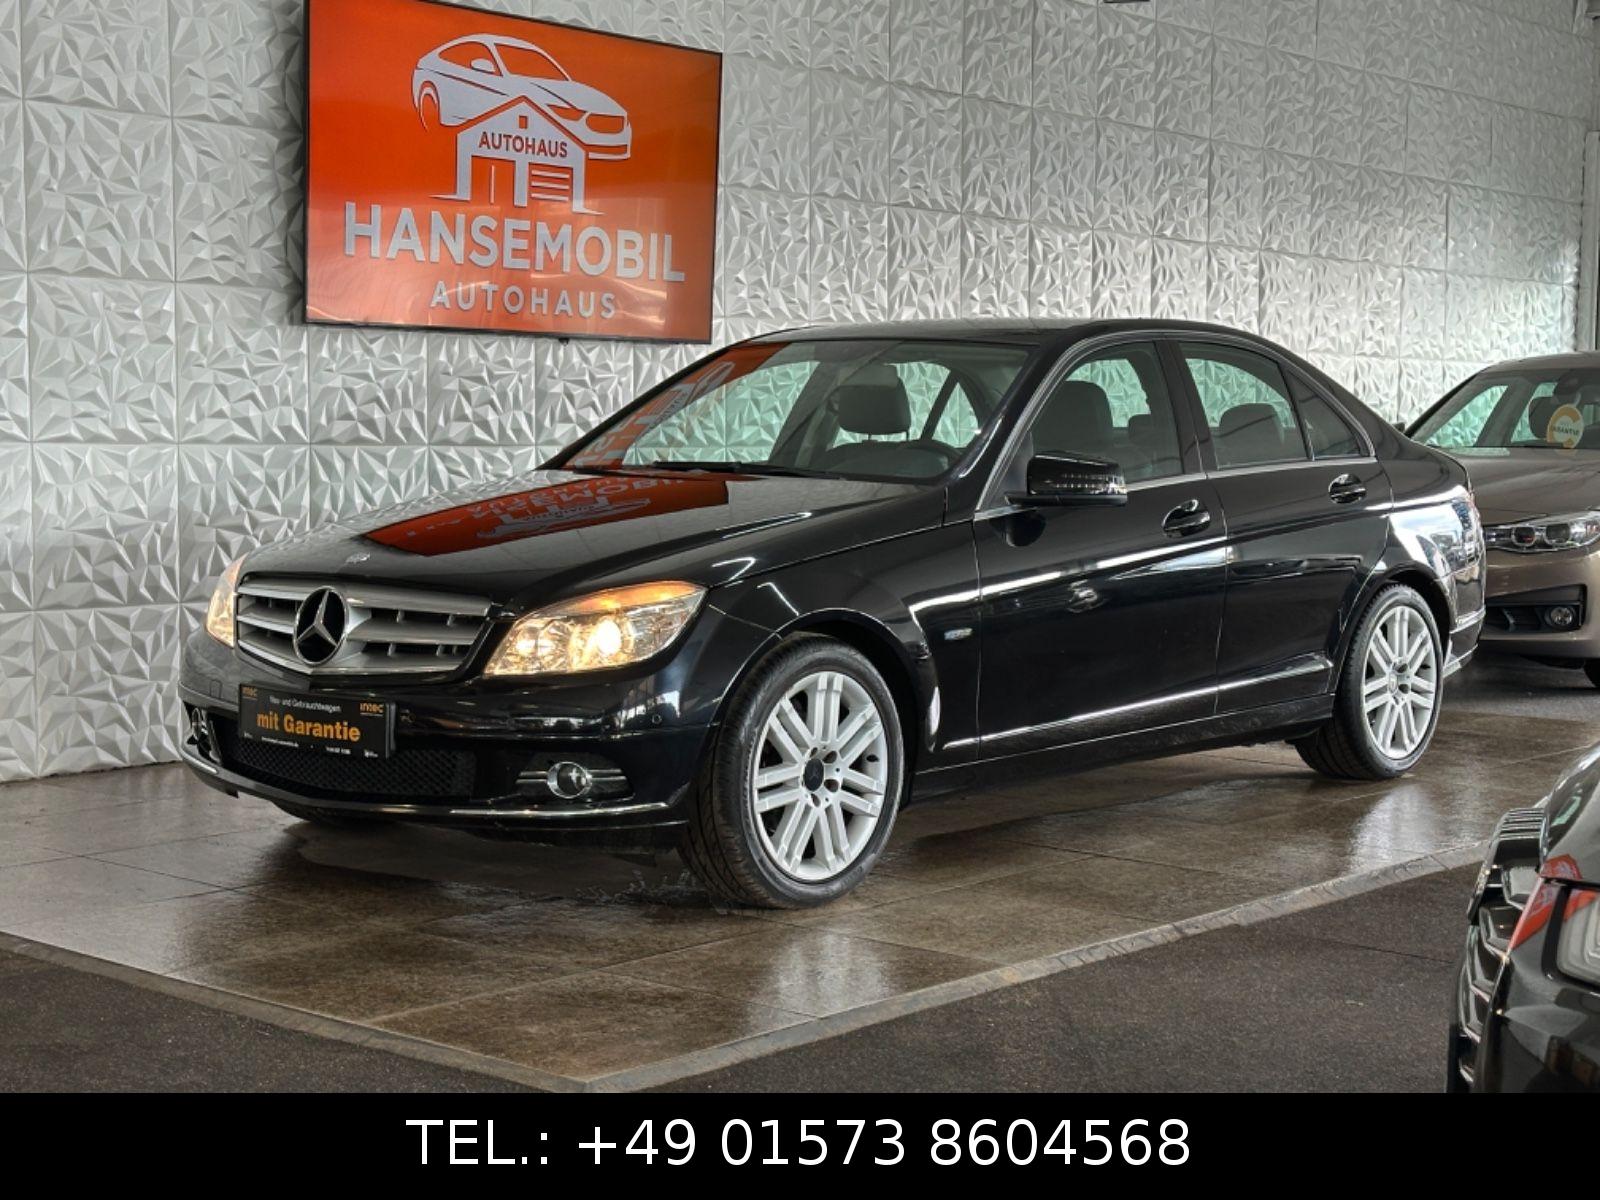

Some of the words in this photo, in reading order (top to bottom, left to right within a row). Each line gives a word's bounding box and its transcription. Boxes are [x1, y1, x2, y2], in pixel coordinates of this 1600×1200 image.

[478, 131, 568, 159] AUTOHAUS
[344, 201, 685, 282] HANSEMOBIL
[430, 280, 616, 319] AUTOHAUS
[256, 711, 281, 731] mit
[283, 713, 362, 742] Garantie
